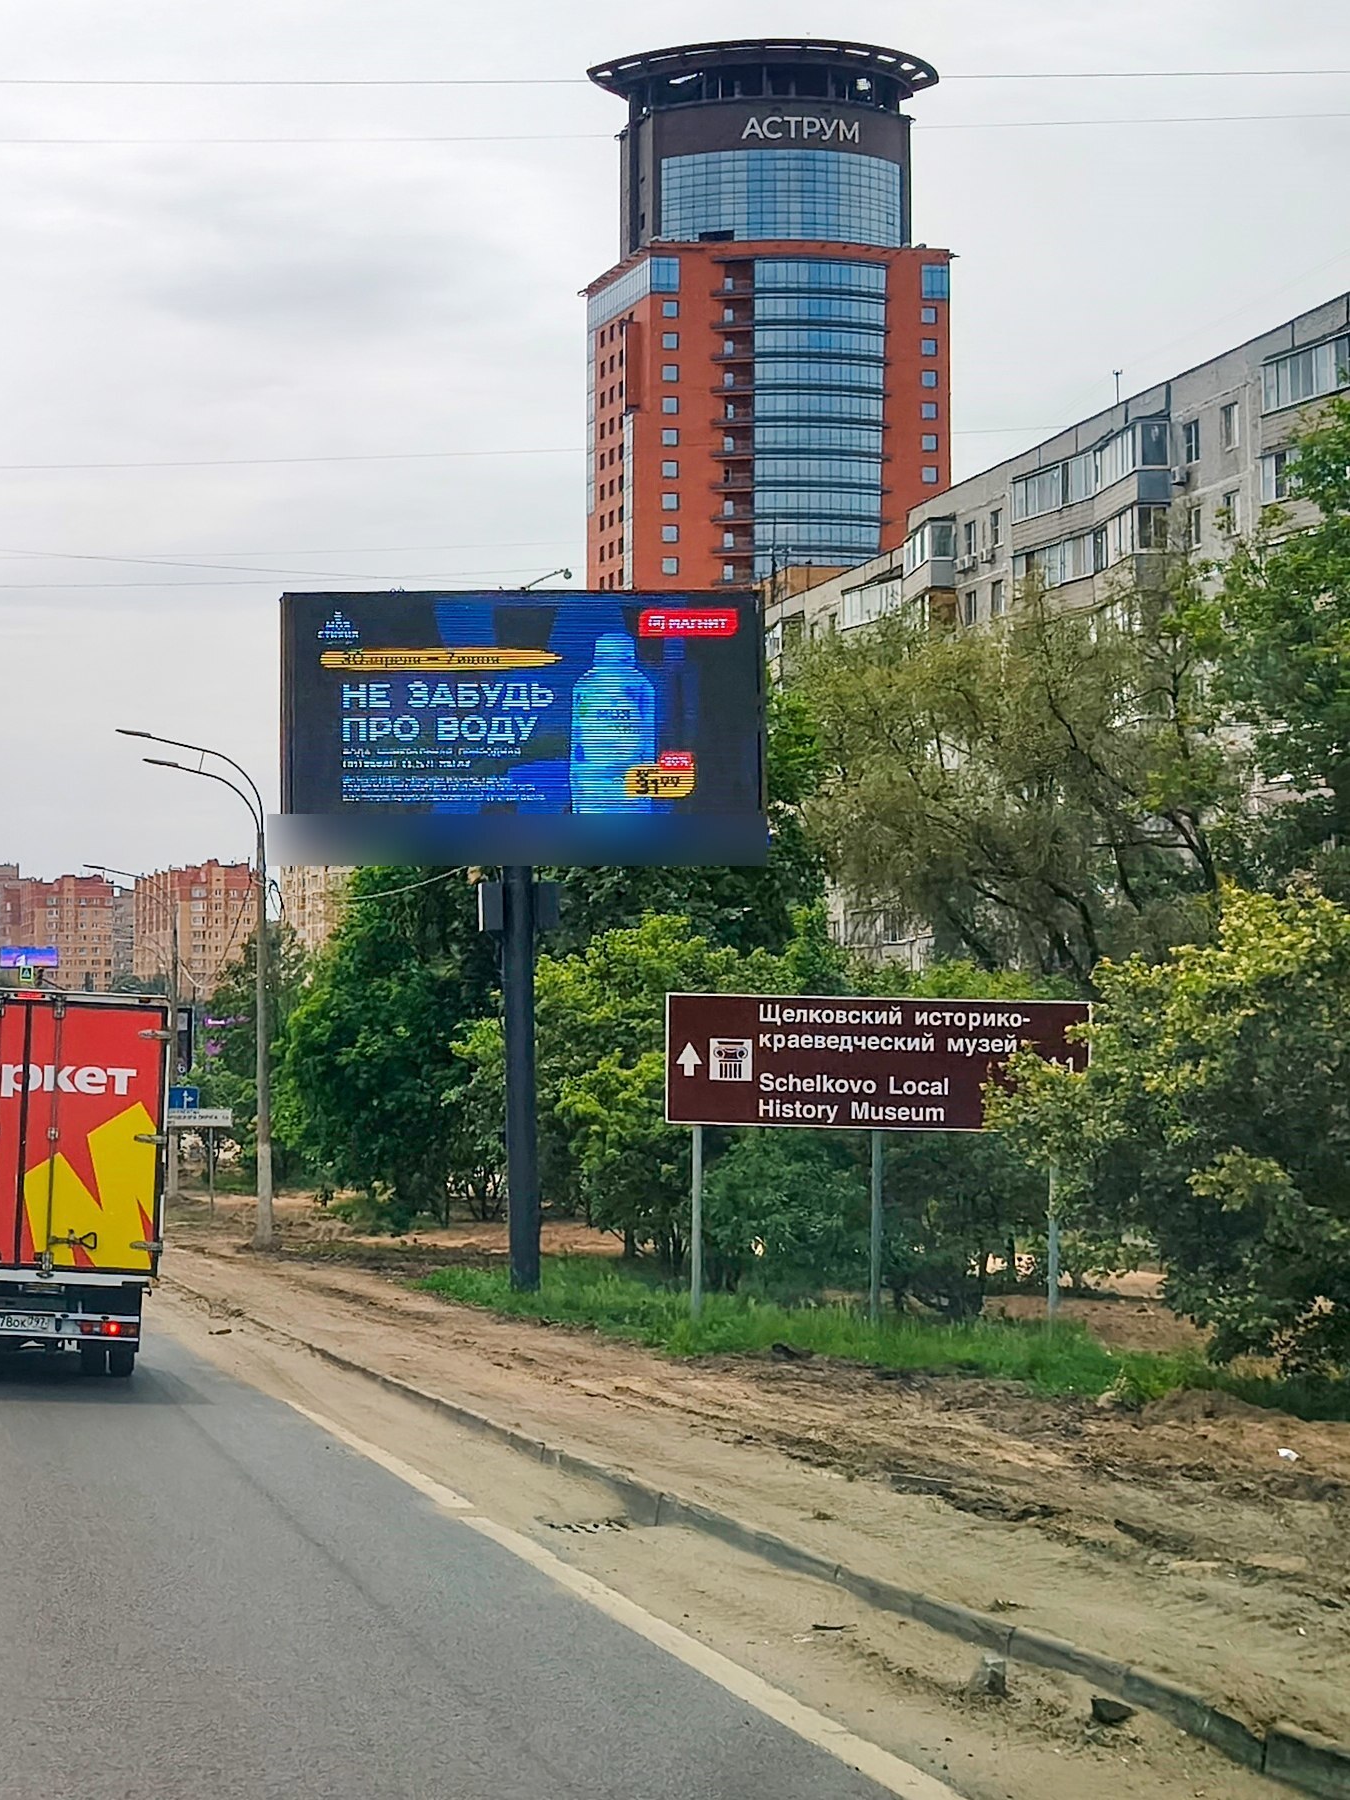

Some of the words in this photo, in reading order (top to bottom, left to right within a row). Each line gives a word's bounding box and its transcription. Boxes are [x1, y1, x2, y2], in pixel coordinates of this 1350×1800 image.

[741, 116, 859, 143] АСТРУМ
[668, 618, 728, 629] МАГНИТ
[342, 683, 391, 708] НЕ
[407, 681, 555, 710] ЗАБУДЬ
[342, 715, 420, 742] ПРО
[437, 715, 538, 744] ВОДУ
[759, 1004, 902, 1026] Щелковский
[914, 1009, 1031, 1031] историко-
[759, 1032, 935, 1053] краеведческий
[947, 1034, 1017, 1057] музей
[759, 1072, 877, 1095] Schelkovo
[889, 1076, 949, 1096] Local
[758, 1099, 839, 1123] History
[850, 1101, 946, 1122] Museum
